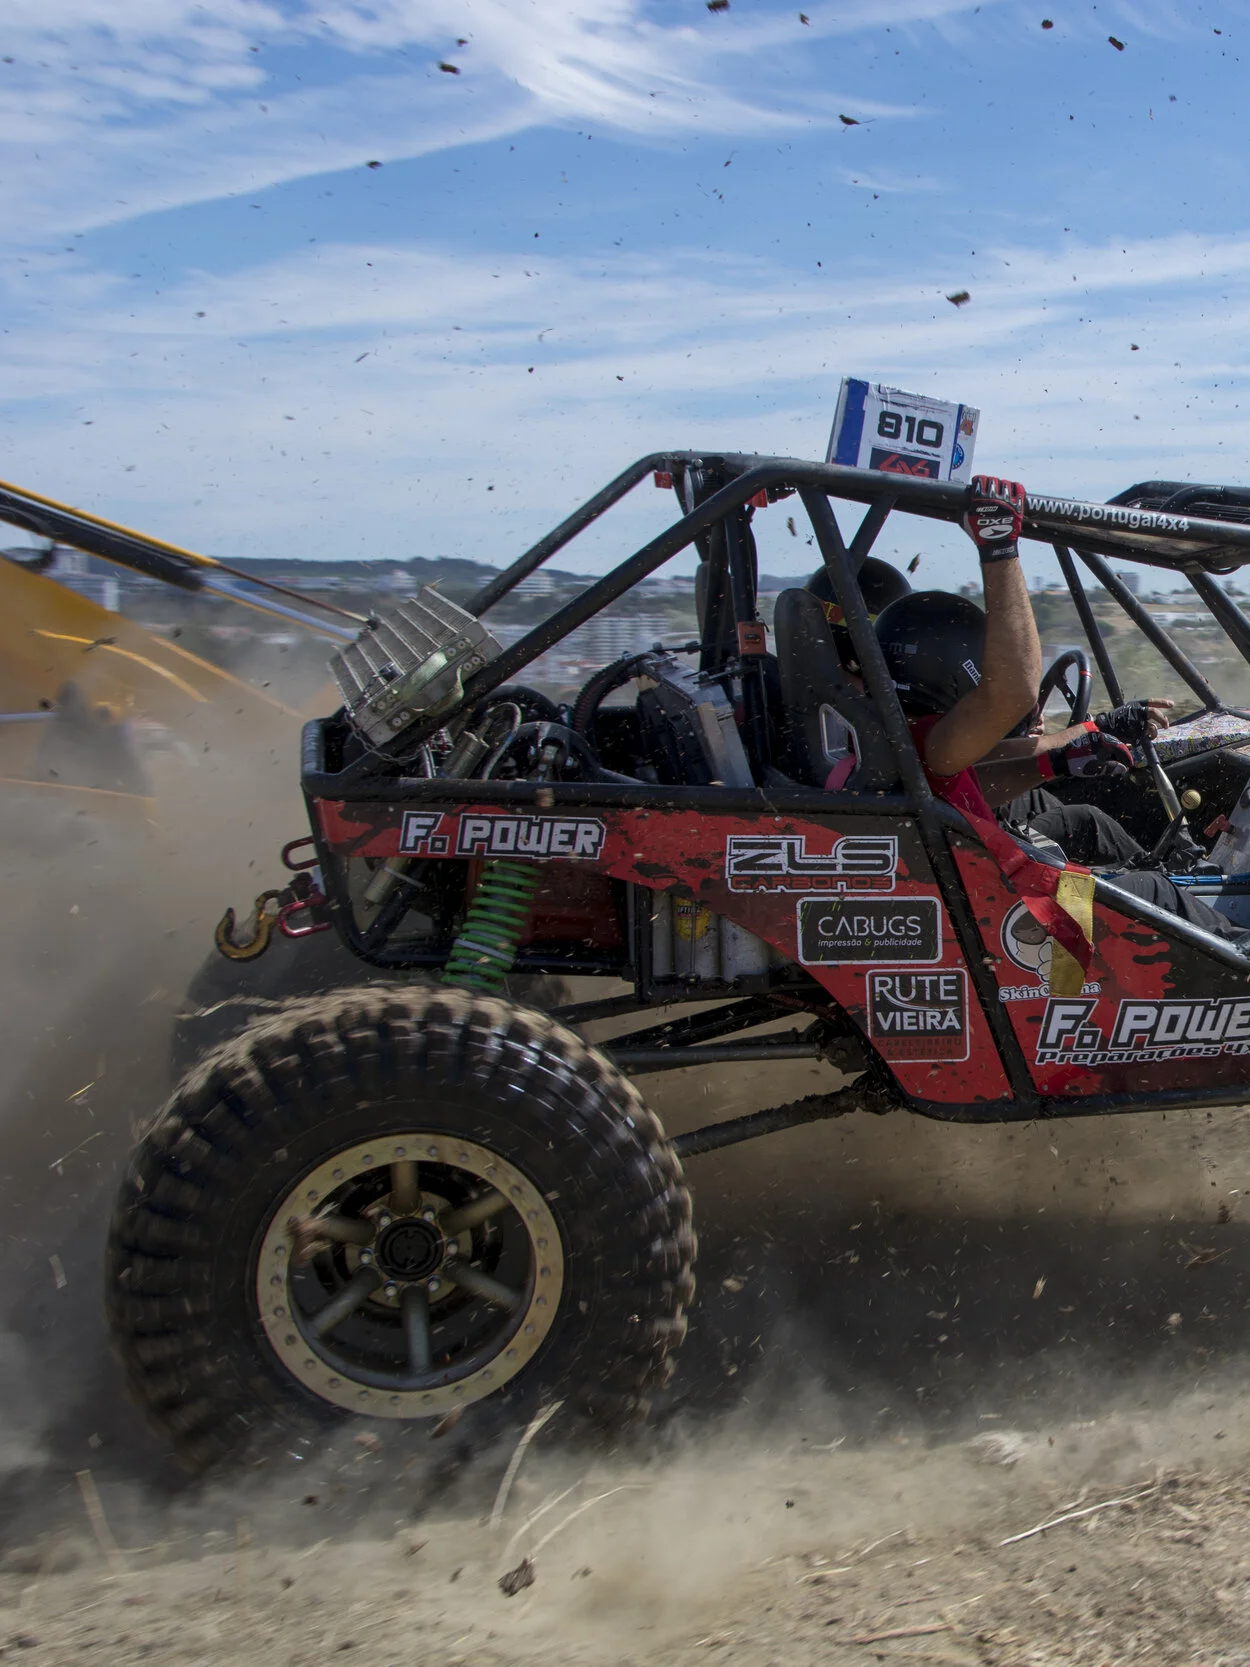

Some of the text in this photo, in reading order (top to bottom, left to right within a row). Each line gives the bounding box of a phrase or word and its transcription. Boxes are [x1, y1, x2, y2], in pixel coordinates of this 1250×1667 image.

[877, 410, 944, 449] 810
[402, 813, 604, 857] F. POWER
[729, 836, 897, 876] ZLS
[731, 875, 892, 889] CARBONOS
[817, 915, 922, 936] CABUGS
[818, 936, 922, 948] impressão & publicidade
[874, 975, 959, 1002] RUTE
[875, 1009, 961, 1031] VIEIRA
[1041, 1001, 1099, 1048] F.
[1036, 1043, 1221, 1067] Preparações
